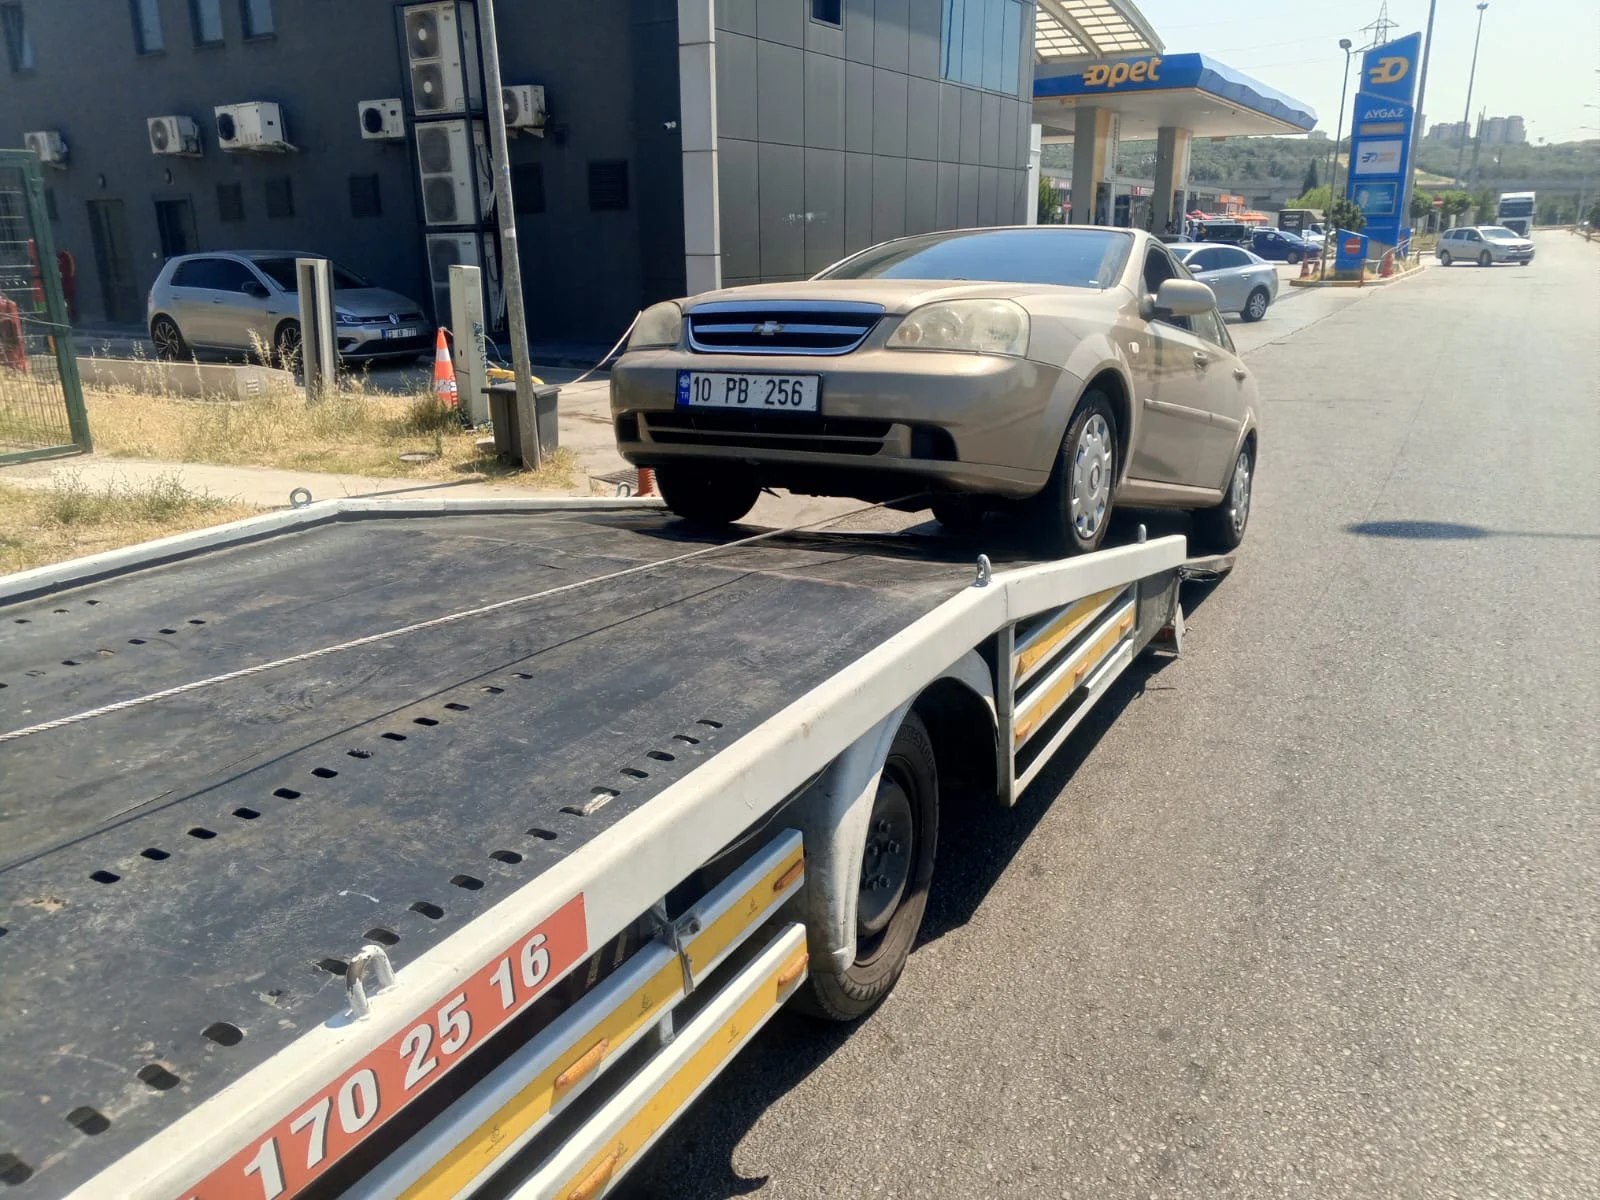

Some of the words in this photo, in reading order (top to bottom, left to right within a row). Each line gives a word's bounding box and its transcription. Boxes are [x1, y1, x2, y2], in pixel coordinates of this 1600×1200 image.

[1364, 108, 1404, 119] AYGAZ
[693, 376, 712, 402] 10
[725, 378, 749, 404] PB
[764, 379, 803, 406] 256
[244, 1069, 379, 1200] 170
[400, 992, 472, 1091] 25
[490, 933, 550, 1010] 16
